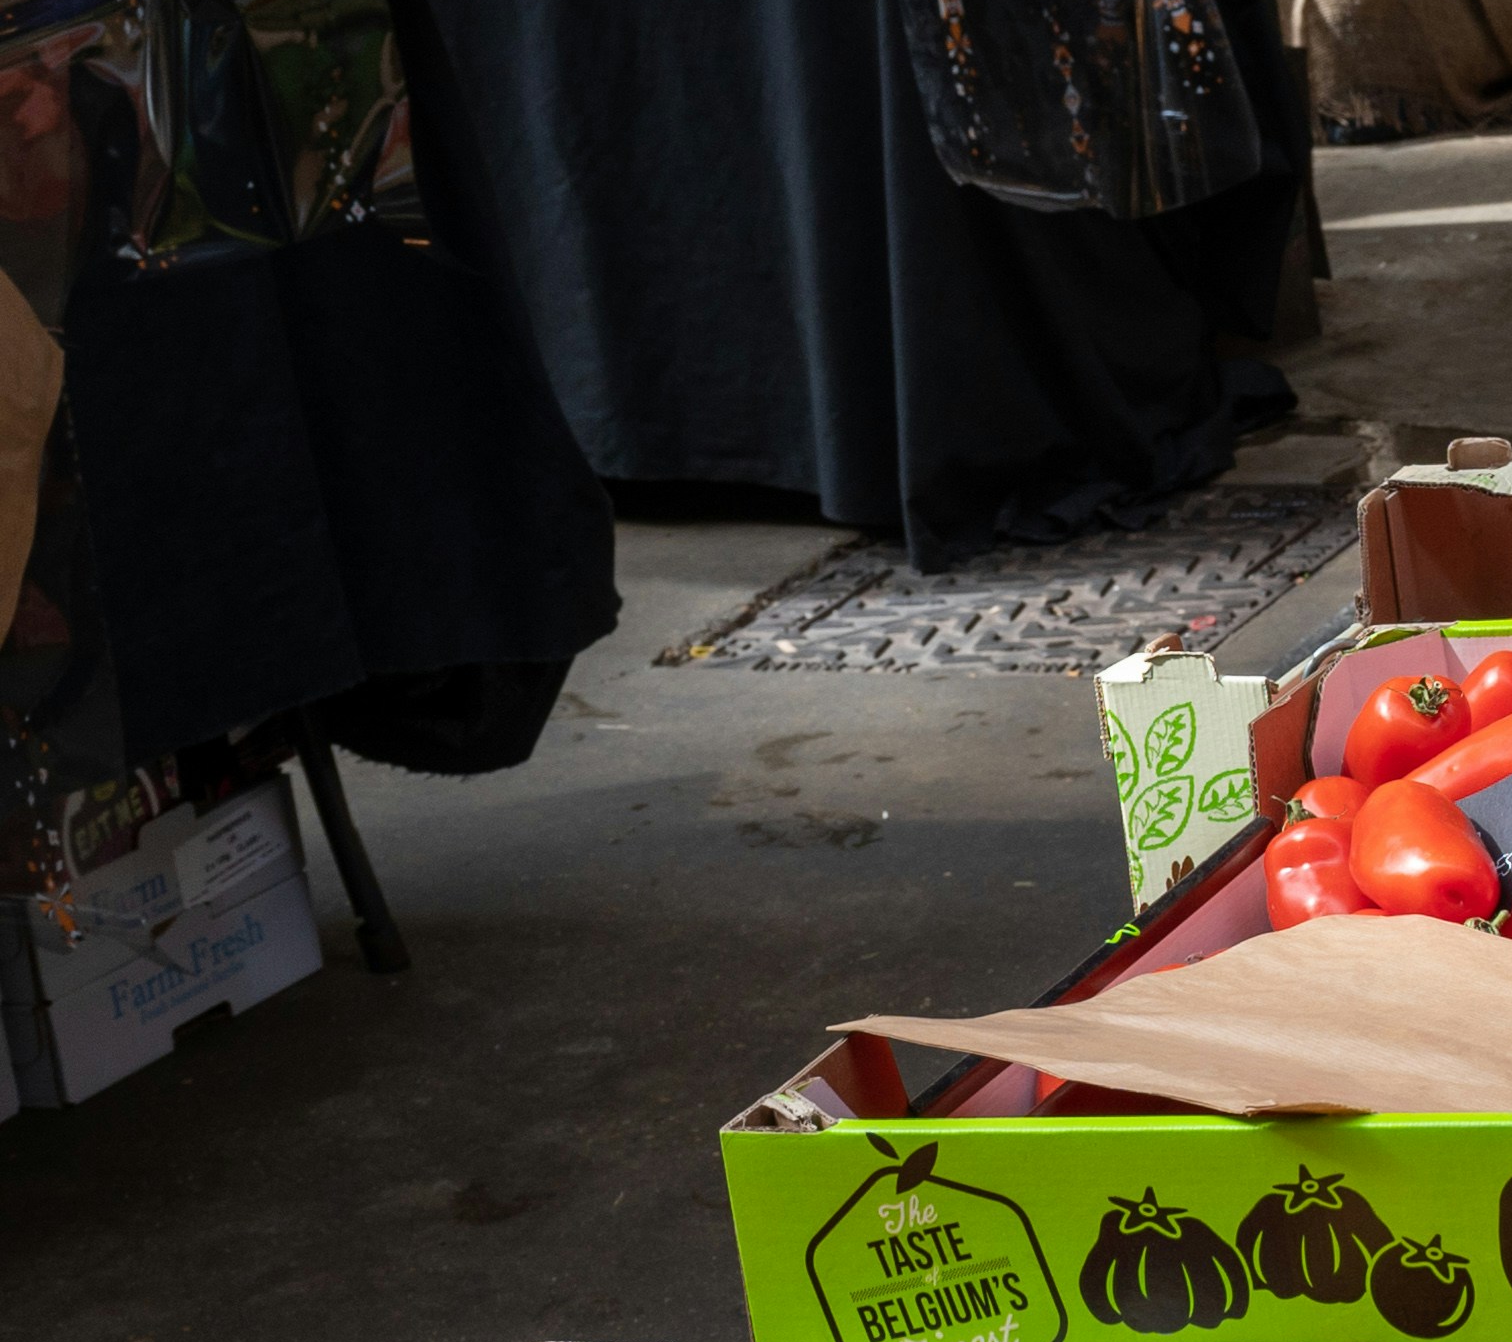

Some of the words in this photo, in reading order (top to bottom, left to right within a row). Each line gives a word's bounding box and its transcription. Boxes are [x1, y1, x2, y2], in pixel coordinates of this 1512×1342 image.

[107, 965, 184, 1019] Farm
[188, 913, 265, 976] Fresh
[878, 1195, 938, 1234] The
[867, 1222, 972, 1278] TASTE
[926, 1266, 940, 1286] of
